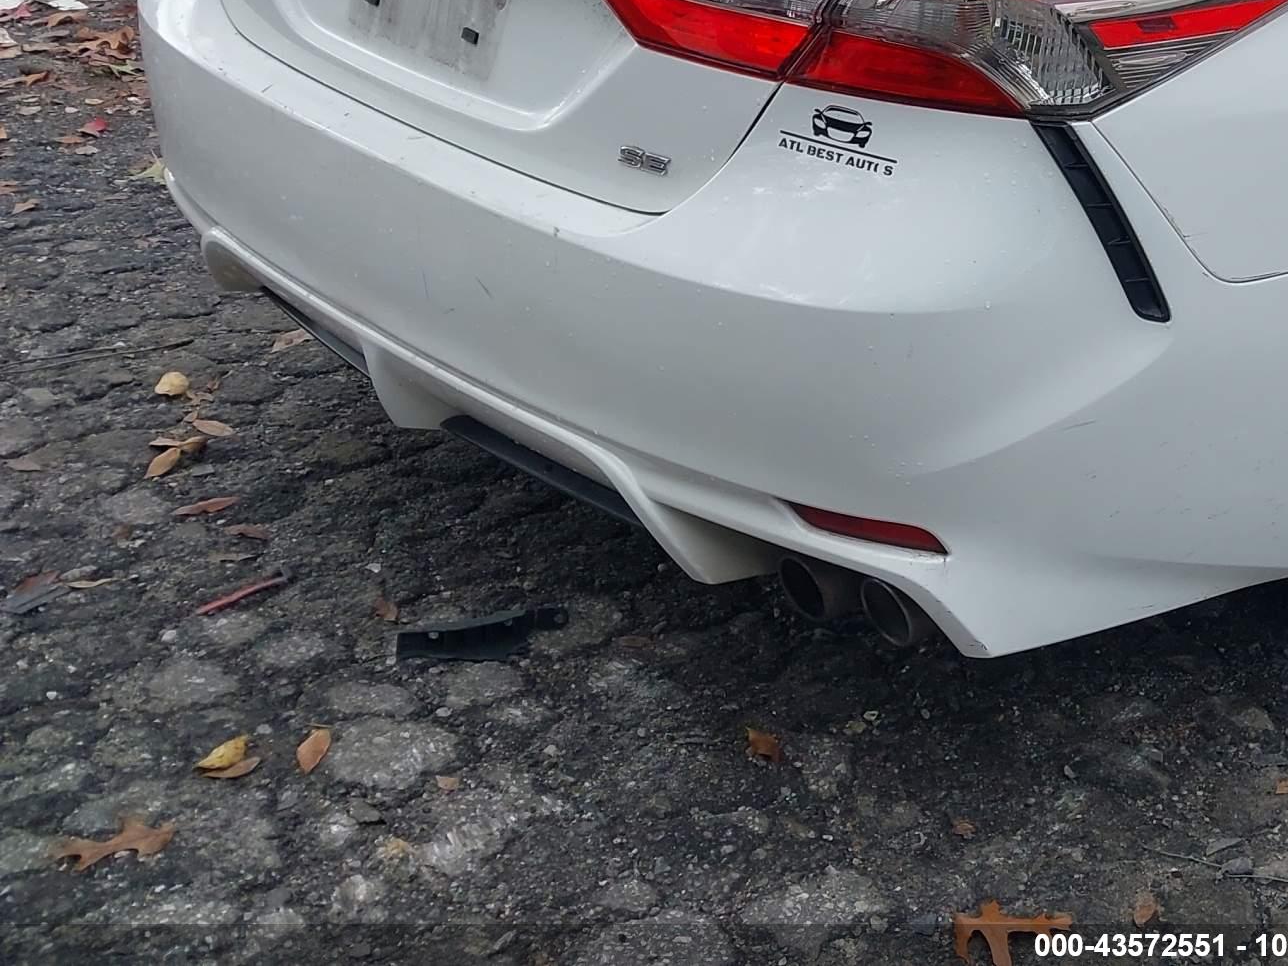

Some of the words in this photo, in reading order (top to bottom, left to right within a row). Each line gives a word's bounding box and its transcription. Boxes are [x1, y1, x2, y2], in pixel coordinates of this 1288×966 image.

[617, 145, 672, 176] SE
[778, 137, 804, 154] ATL
[806, 144, 844, 164] BEST
